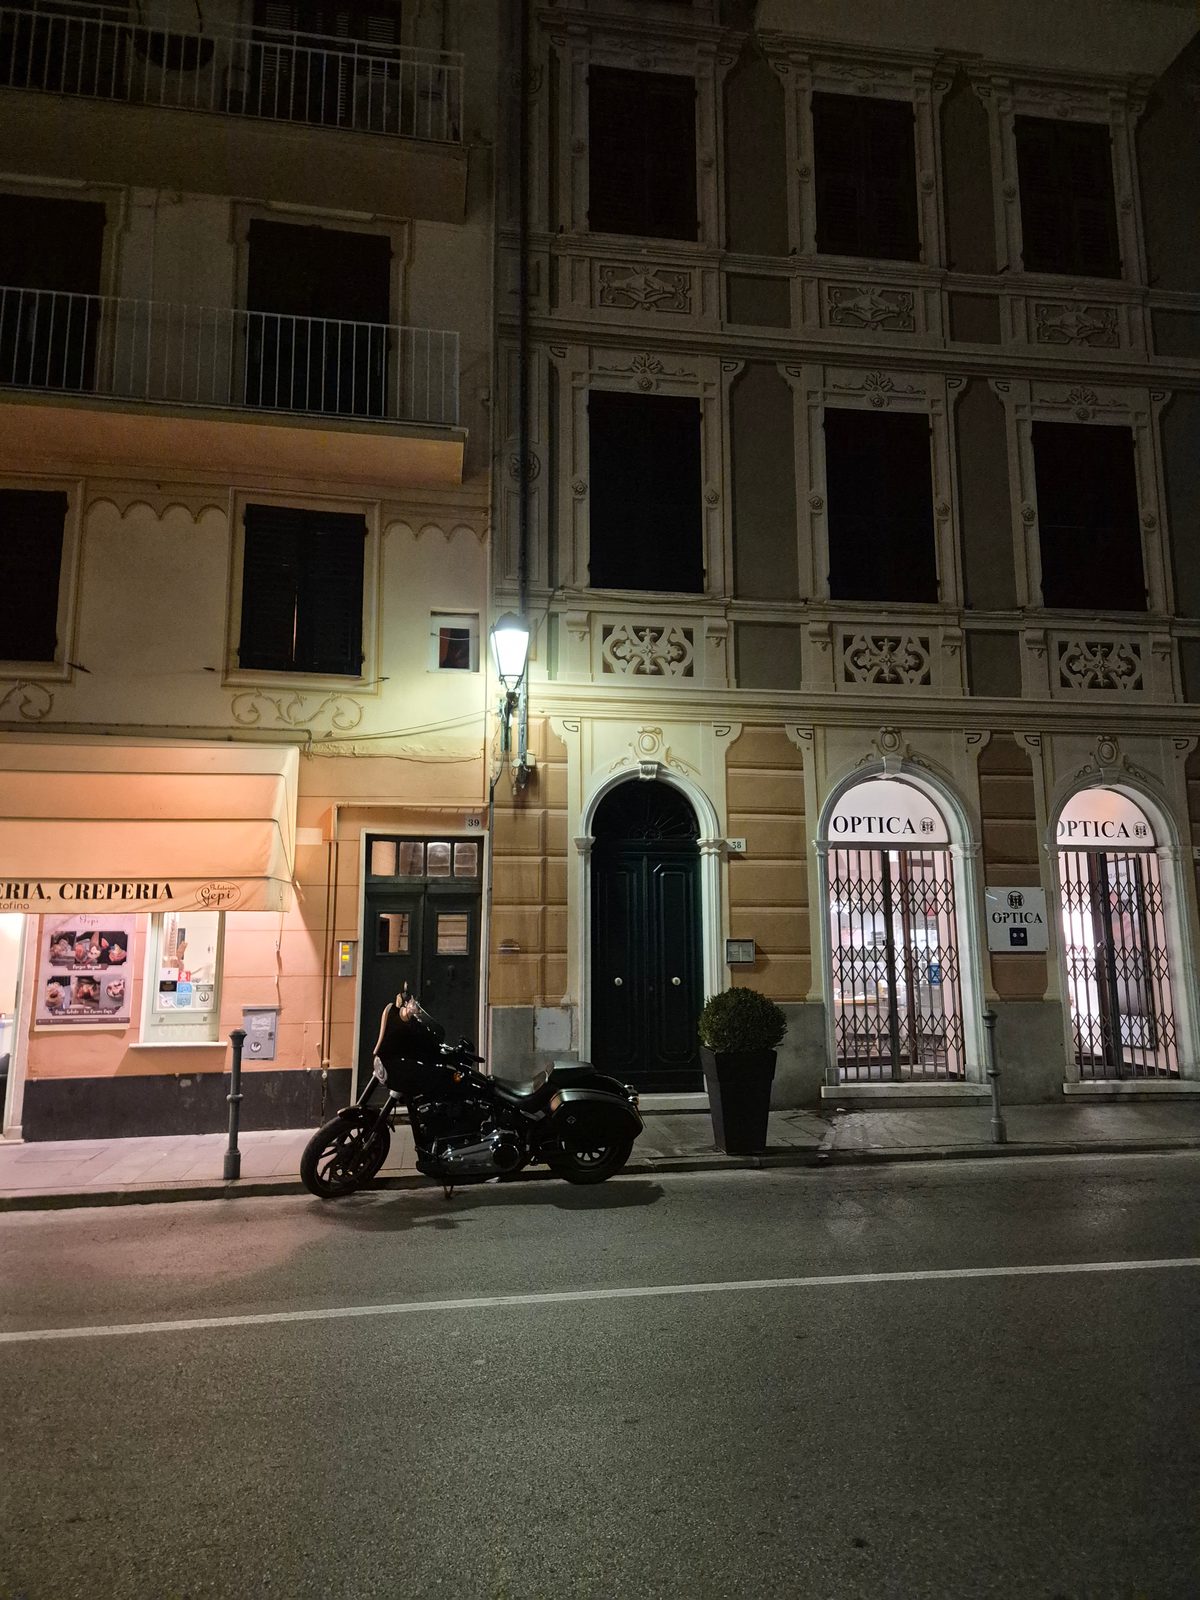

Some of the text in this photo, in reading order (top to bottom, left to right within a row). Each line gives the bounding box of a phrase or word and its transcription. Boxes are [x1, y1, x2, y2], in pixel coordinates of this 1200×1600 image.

[468, 818, 480, 827] 39
[832, 815, 917, 834] OPTICA
[732, 841, 742, 850] 38
[59, 883, 173, 900] CREPERIA
[201, 887, 234, 906] Gepi
[992, 911, 1043, 924] OPTICA
